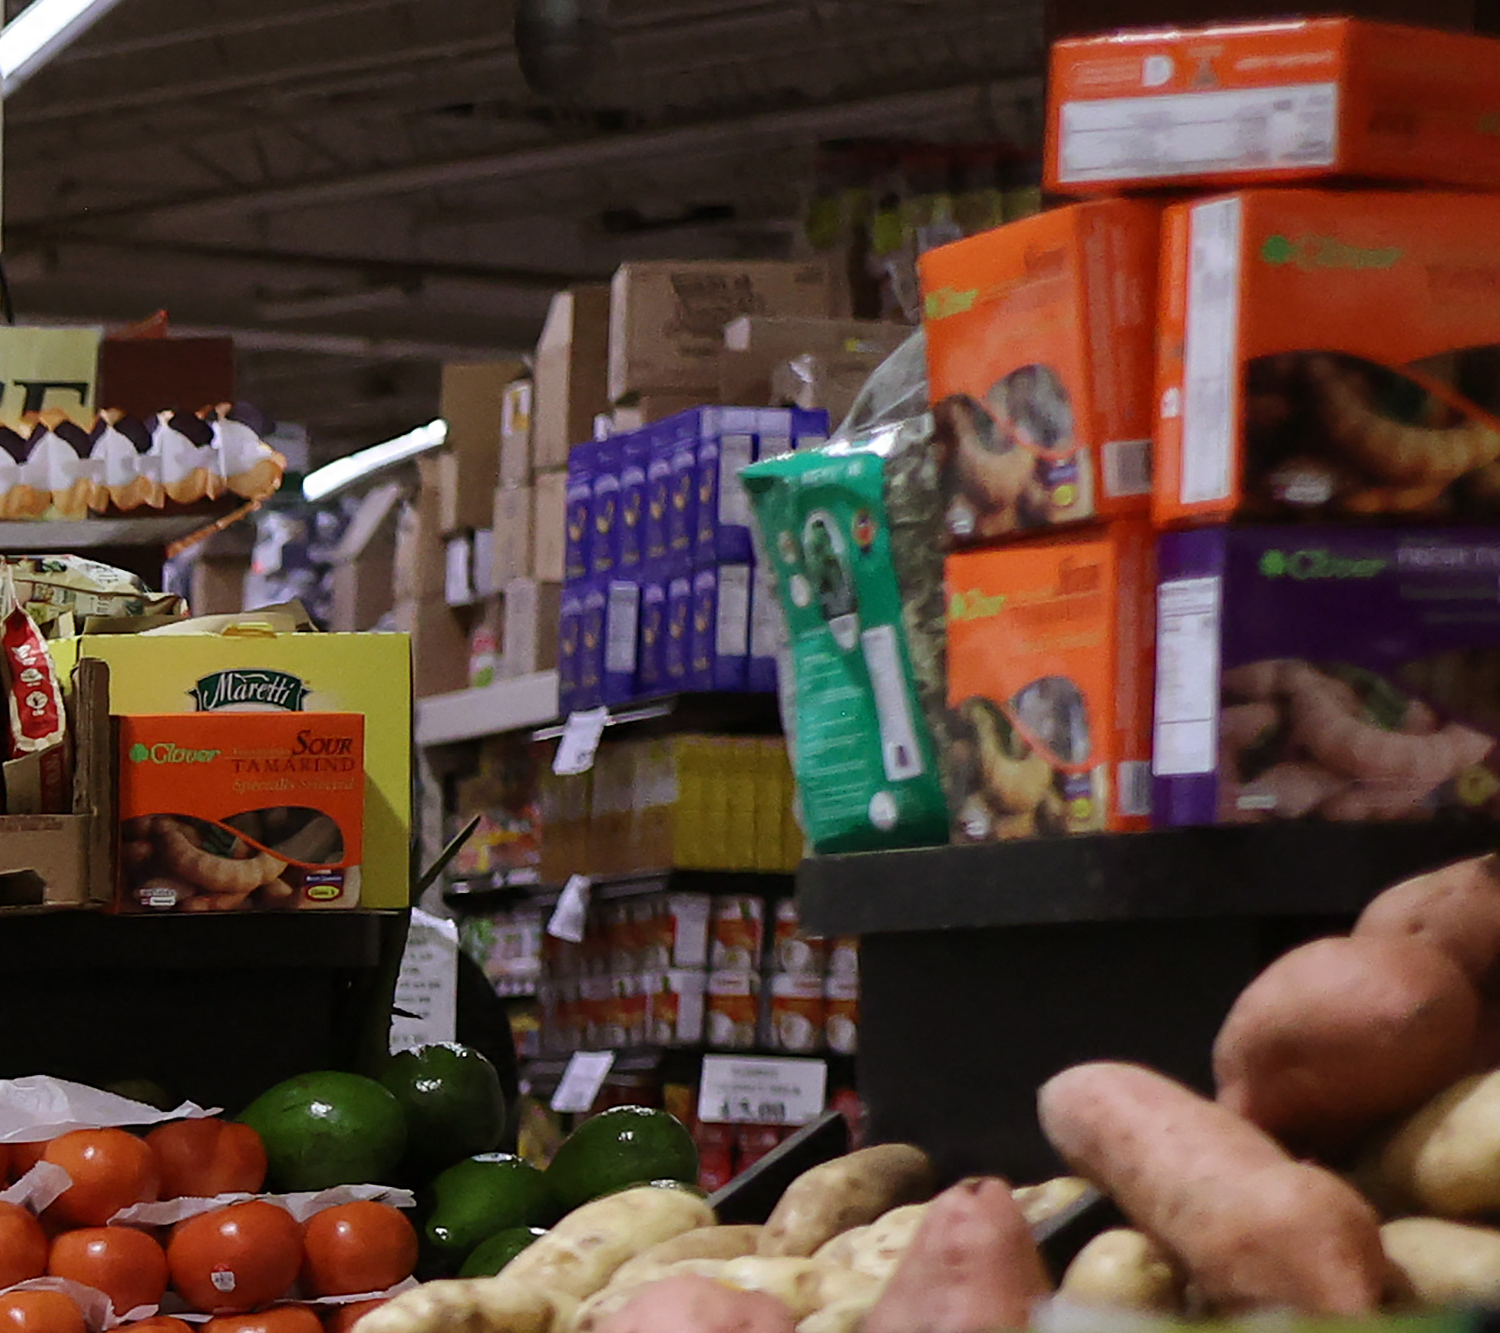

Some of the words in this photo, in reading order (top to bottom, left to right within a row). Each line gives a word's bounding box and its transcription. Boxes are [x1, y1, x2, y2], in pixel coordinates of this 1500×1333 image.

[202, 674, 293, 707] Maretti
[291, 729, 354, 757] SOUR
[233, 757, 356, 775] TAMARIND
